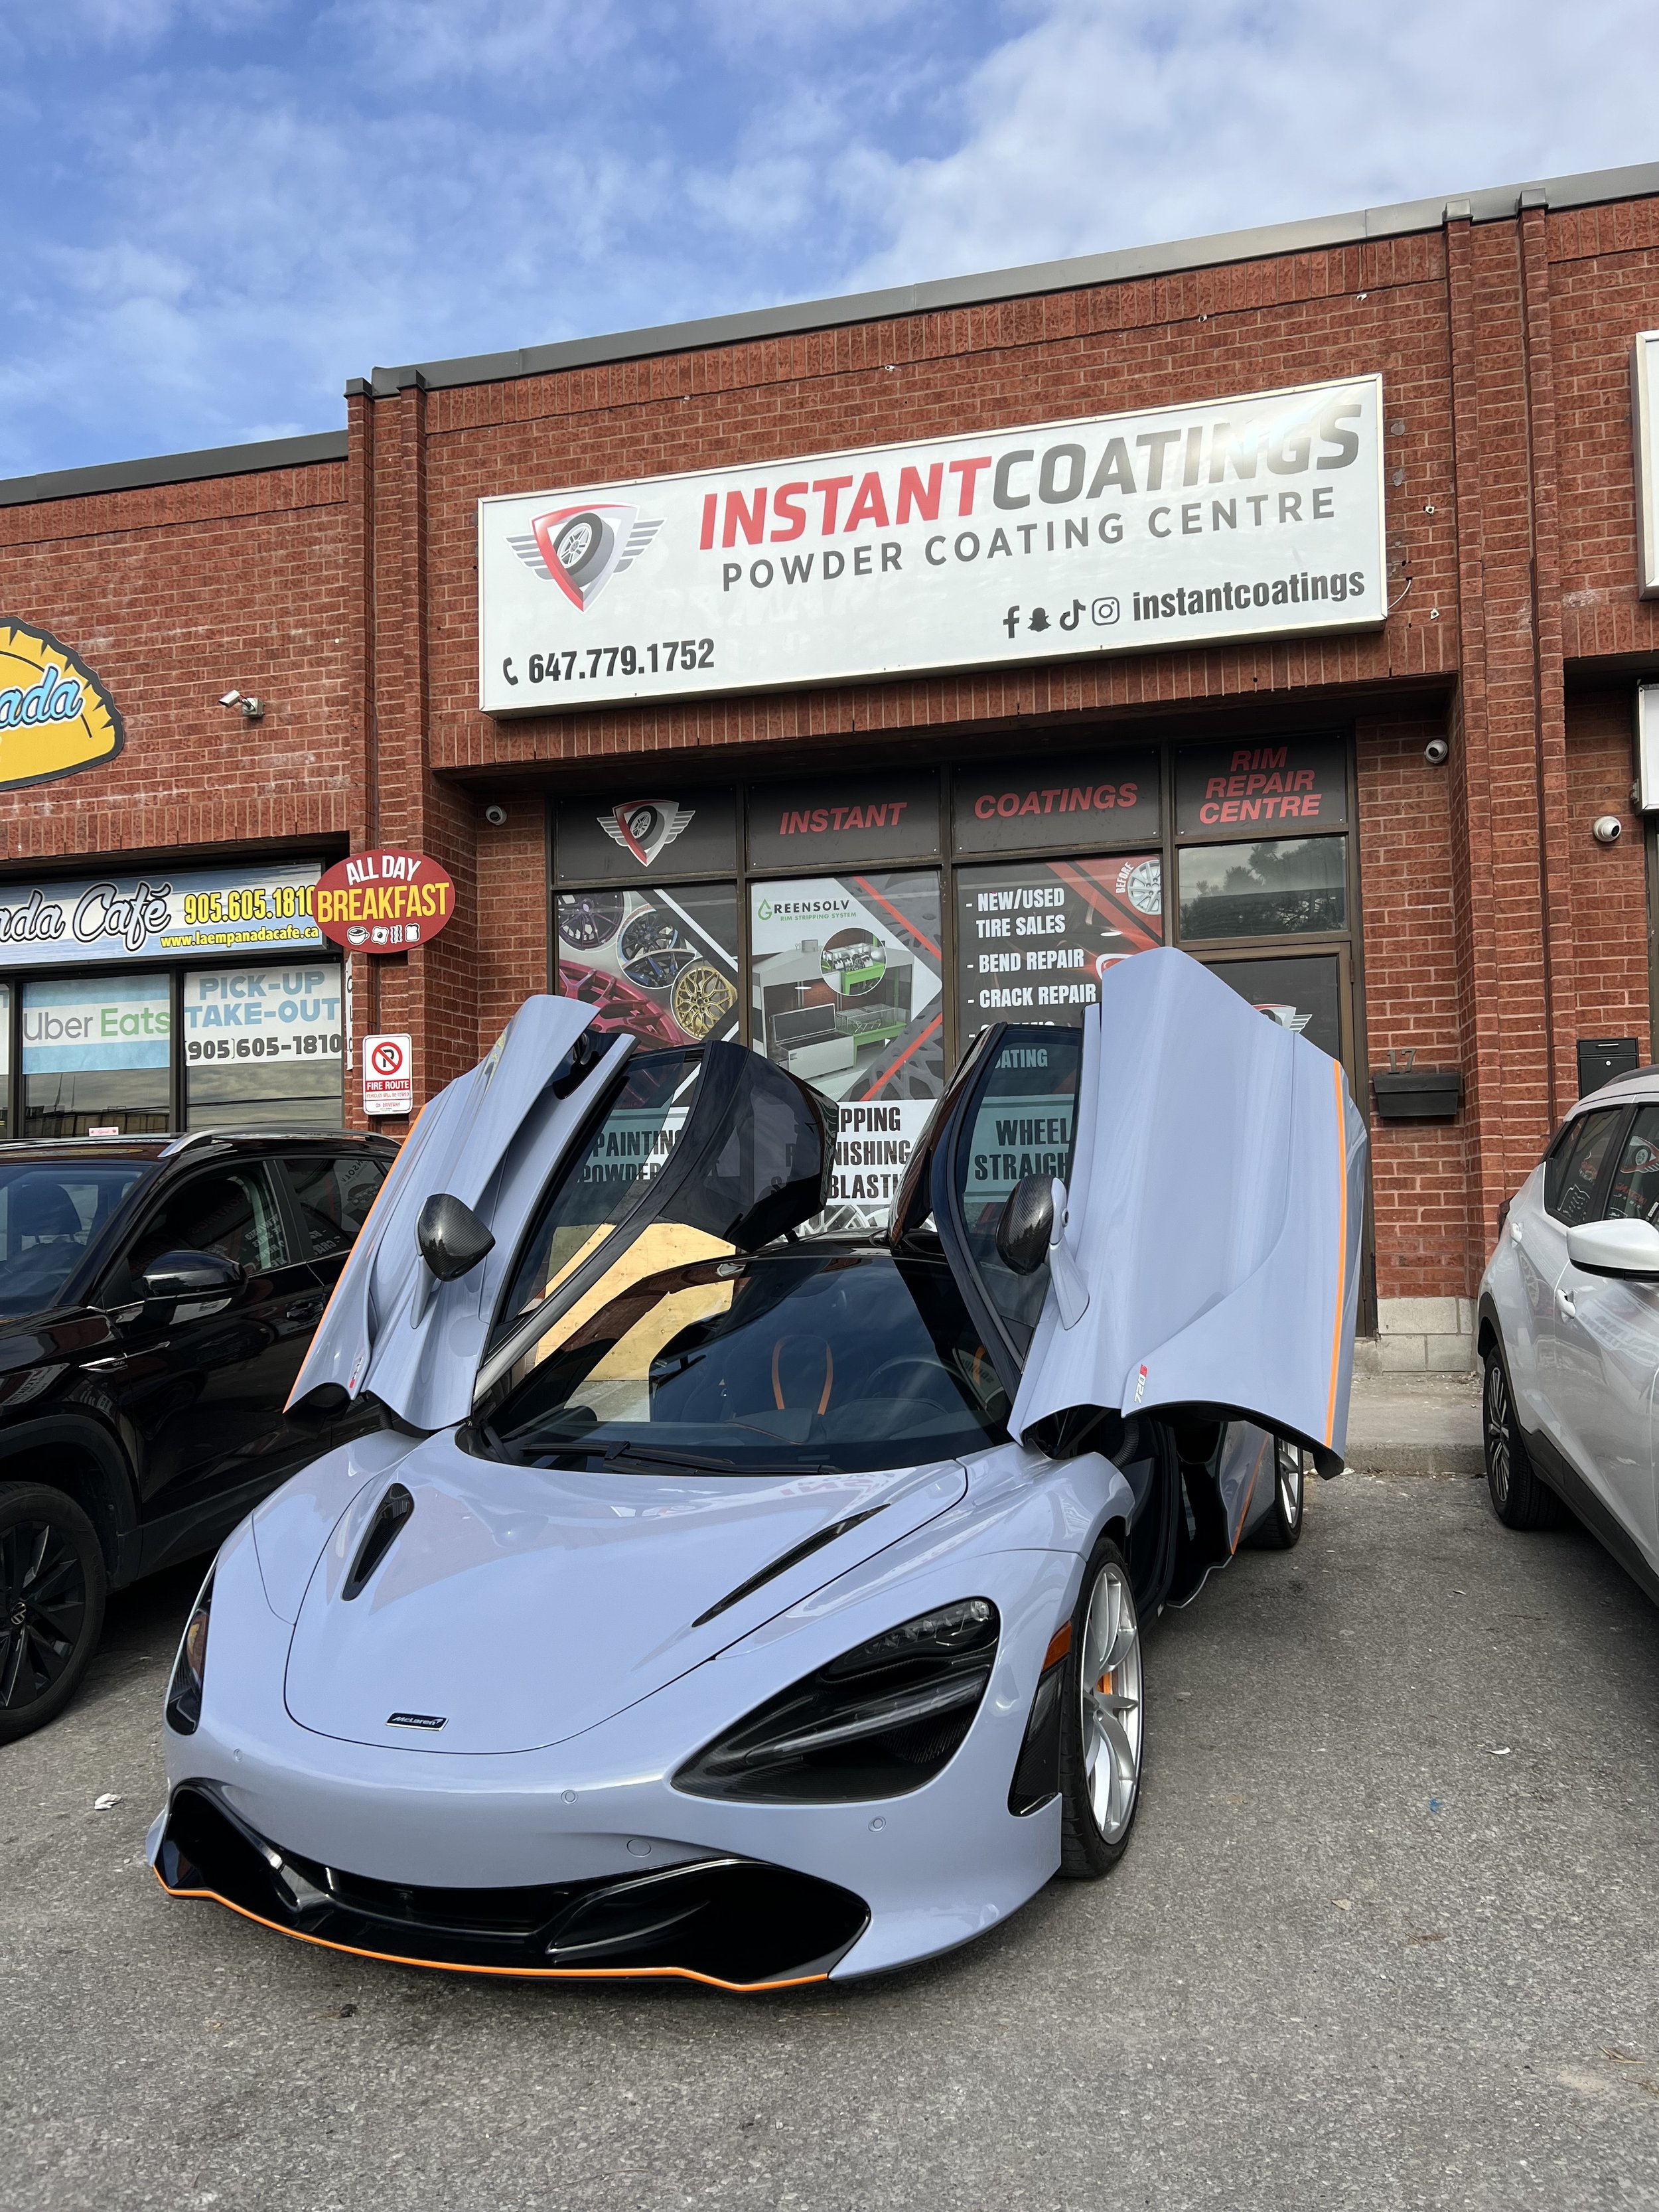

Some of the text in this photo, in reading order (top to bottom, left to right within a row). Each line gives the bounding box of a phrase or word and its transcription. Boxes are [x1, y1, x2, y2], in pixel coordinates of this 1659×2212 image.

[723, 486, 1334, 591] POWDER COATING CENTRE
[1133, 571, 1364, 621] instantcoatings
[529, 638, 714, 684] 647.779.1752
[0, 666, 83, 729] ada
[1230, 747, 1287, 772] RIM
[1206, 769, 1315, 799] REPAIR
[974, 782, 1139, 819] COATINGS
[1199, 794, 1322, 824] CENTRE
[780, 802, 907, 835] INSTANT
[346, 855, 422, 886] ALL DAY
[1116, 862, 1134, 893] BEFORE
[318, 883, 449, 923] BREAKFAST
[977, 888, 1064, 912] NEW/USED
[73, 883, 171, 952] Café
[976, 915, 1066, 938] TIRE SALES
[161, 924, 319, 949] www.laempanadacafe.ca
[979, 949, 1084, 973] BEND REPAIR
[200, 971, 325, 1000] PICK-UP
[979, 984, 1096, 1008] CRACK REPAIR
[24, 1005, 170, 1041] Uber Eats
[185, 997, 340, 1028] TAKE-OUT
[1386, 1049, 1417, 1074] 17
[367, 1080, 409, 1090] FIRE ROUTE
[995, 1118, 1070, 1146] WHEEL
[392, 1716, 438, 1726] McLaren
